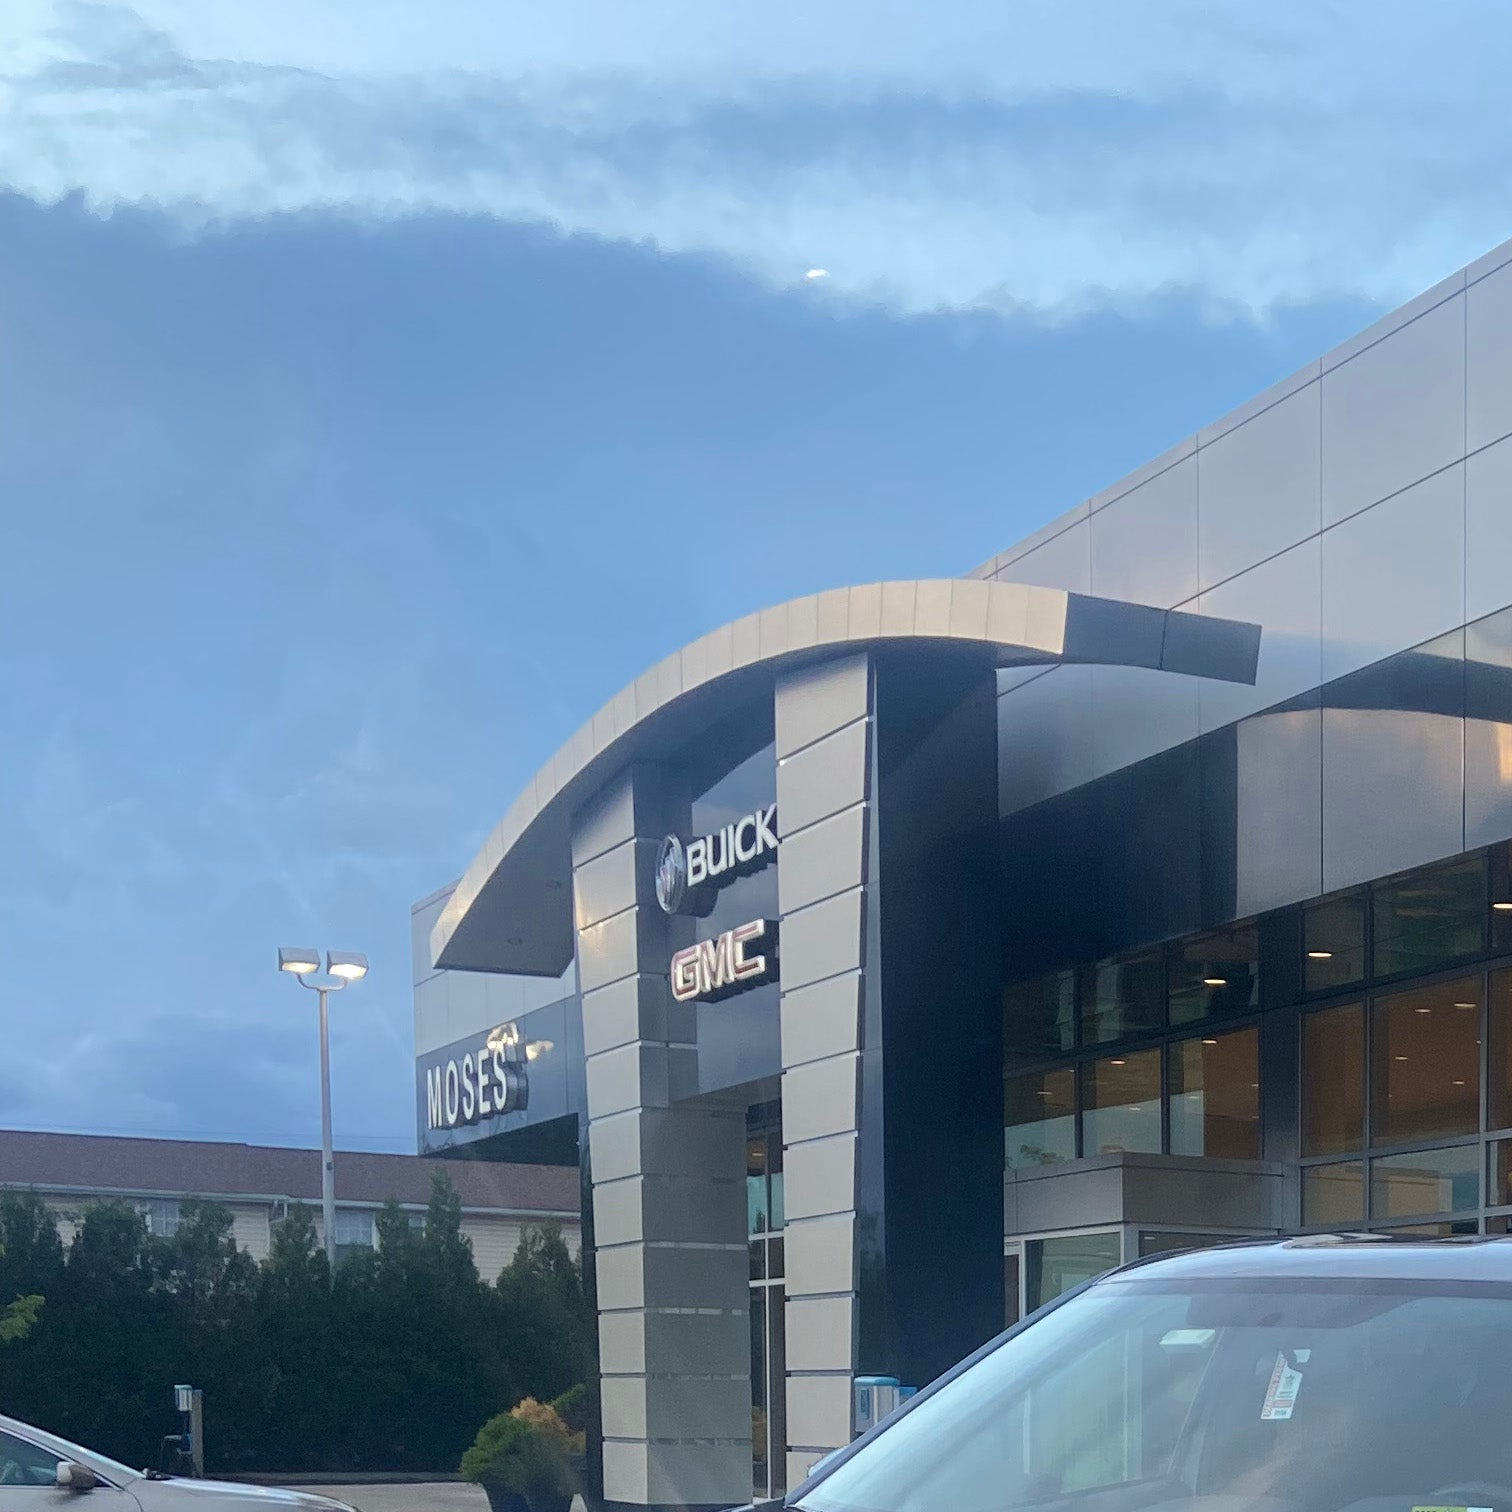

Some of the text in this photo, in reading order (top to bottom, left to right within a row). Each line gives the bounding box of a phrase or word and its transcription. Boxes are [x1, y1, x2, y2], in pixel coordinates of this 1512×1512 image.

[686, 803, 779, 888] BUICK
[670, 918, 766, 1001] GMC
[427, 1047, 507, 1130] MOSES
